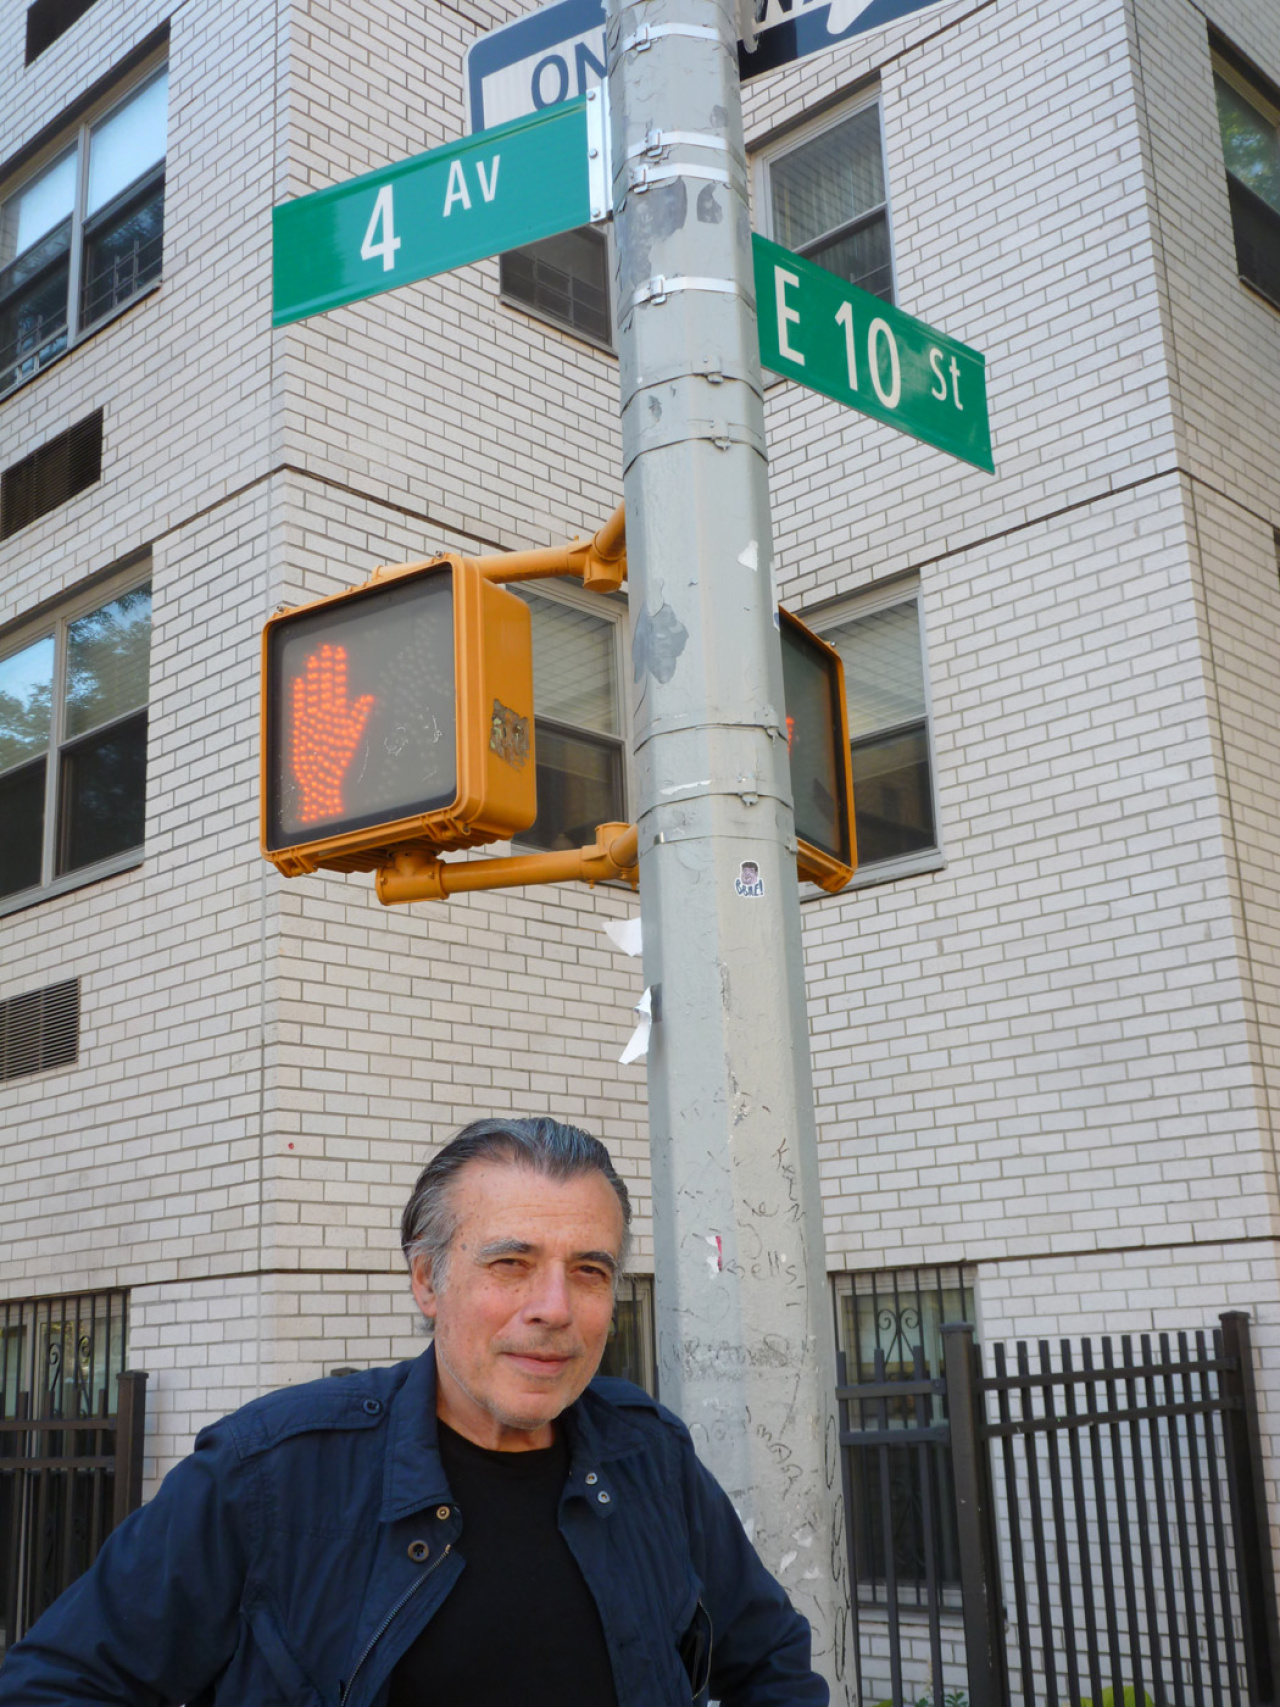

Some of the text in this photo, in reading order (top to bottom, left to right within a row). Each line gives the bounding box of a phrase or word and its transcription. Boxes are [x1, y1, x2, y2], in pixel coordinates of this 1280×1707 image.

[531, 32, 607, 111] ON
[360, 184, 401, 272] 4
[774, 264, 963, 410] E 10 St
